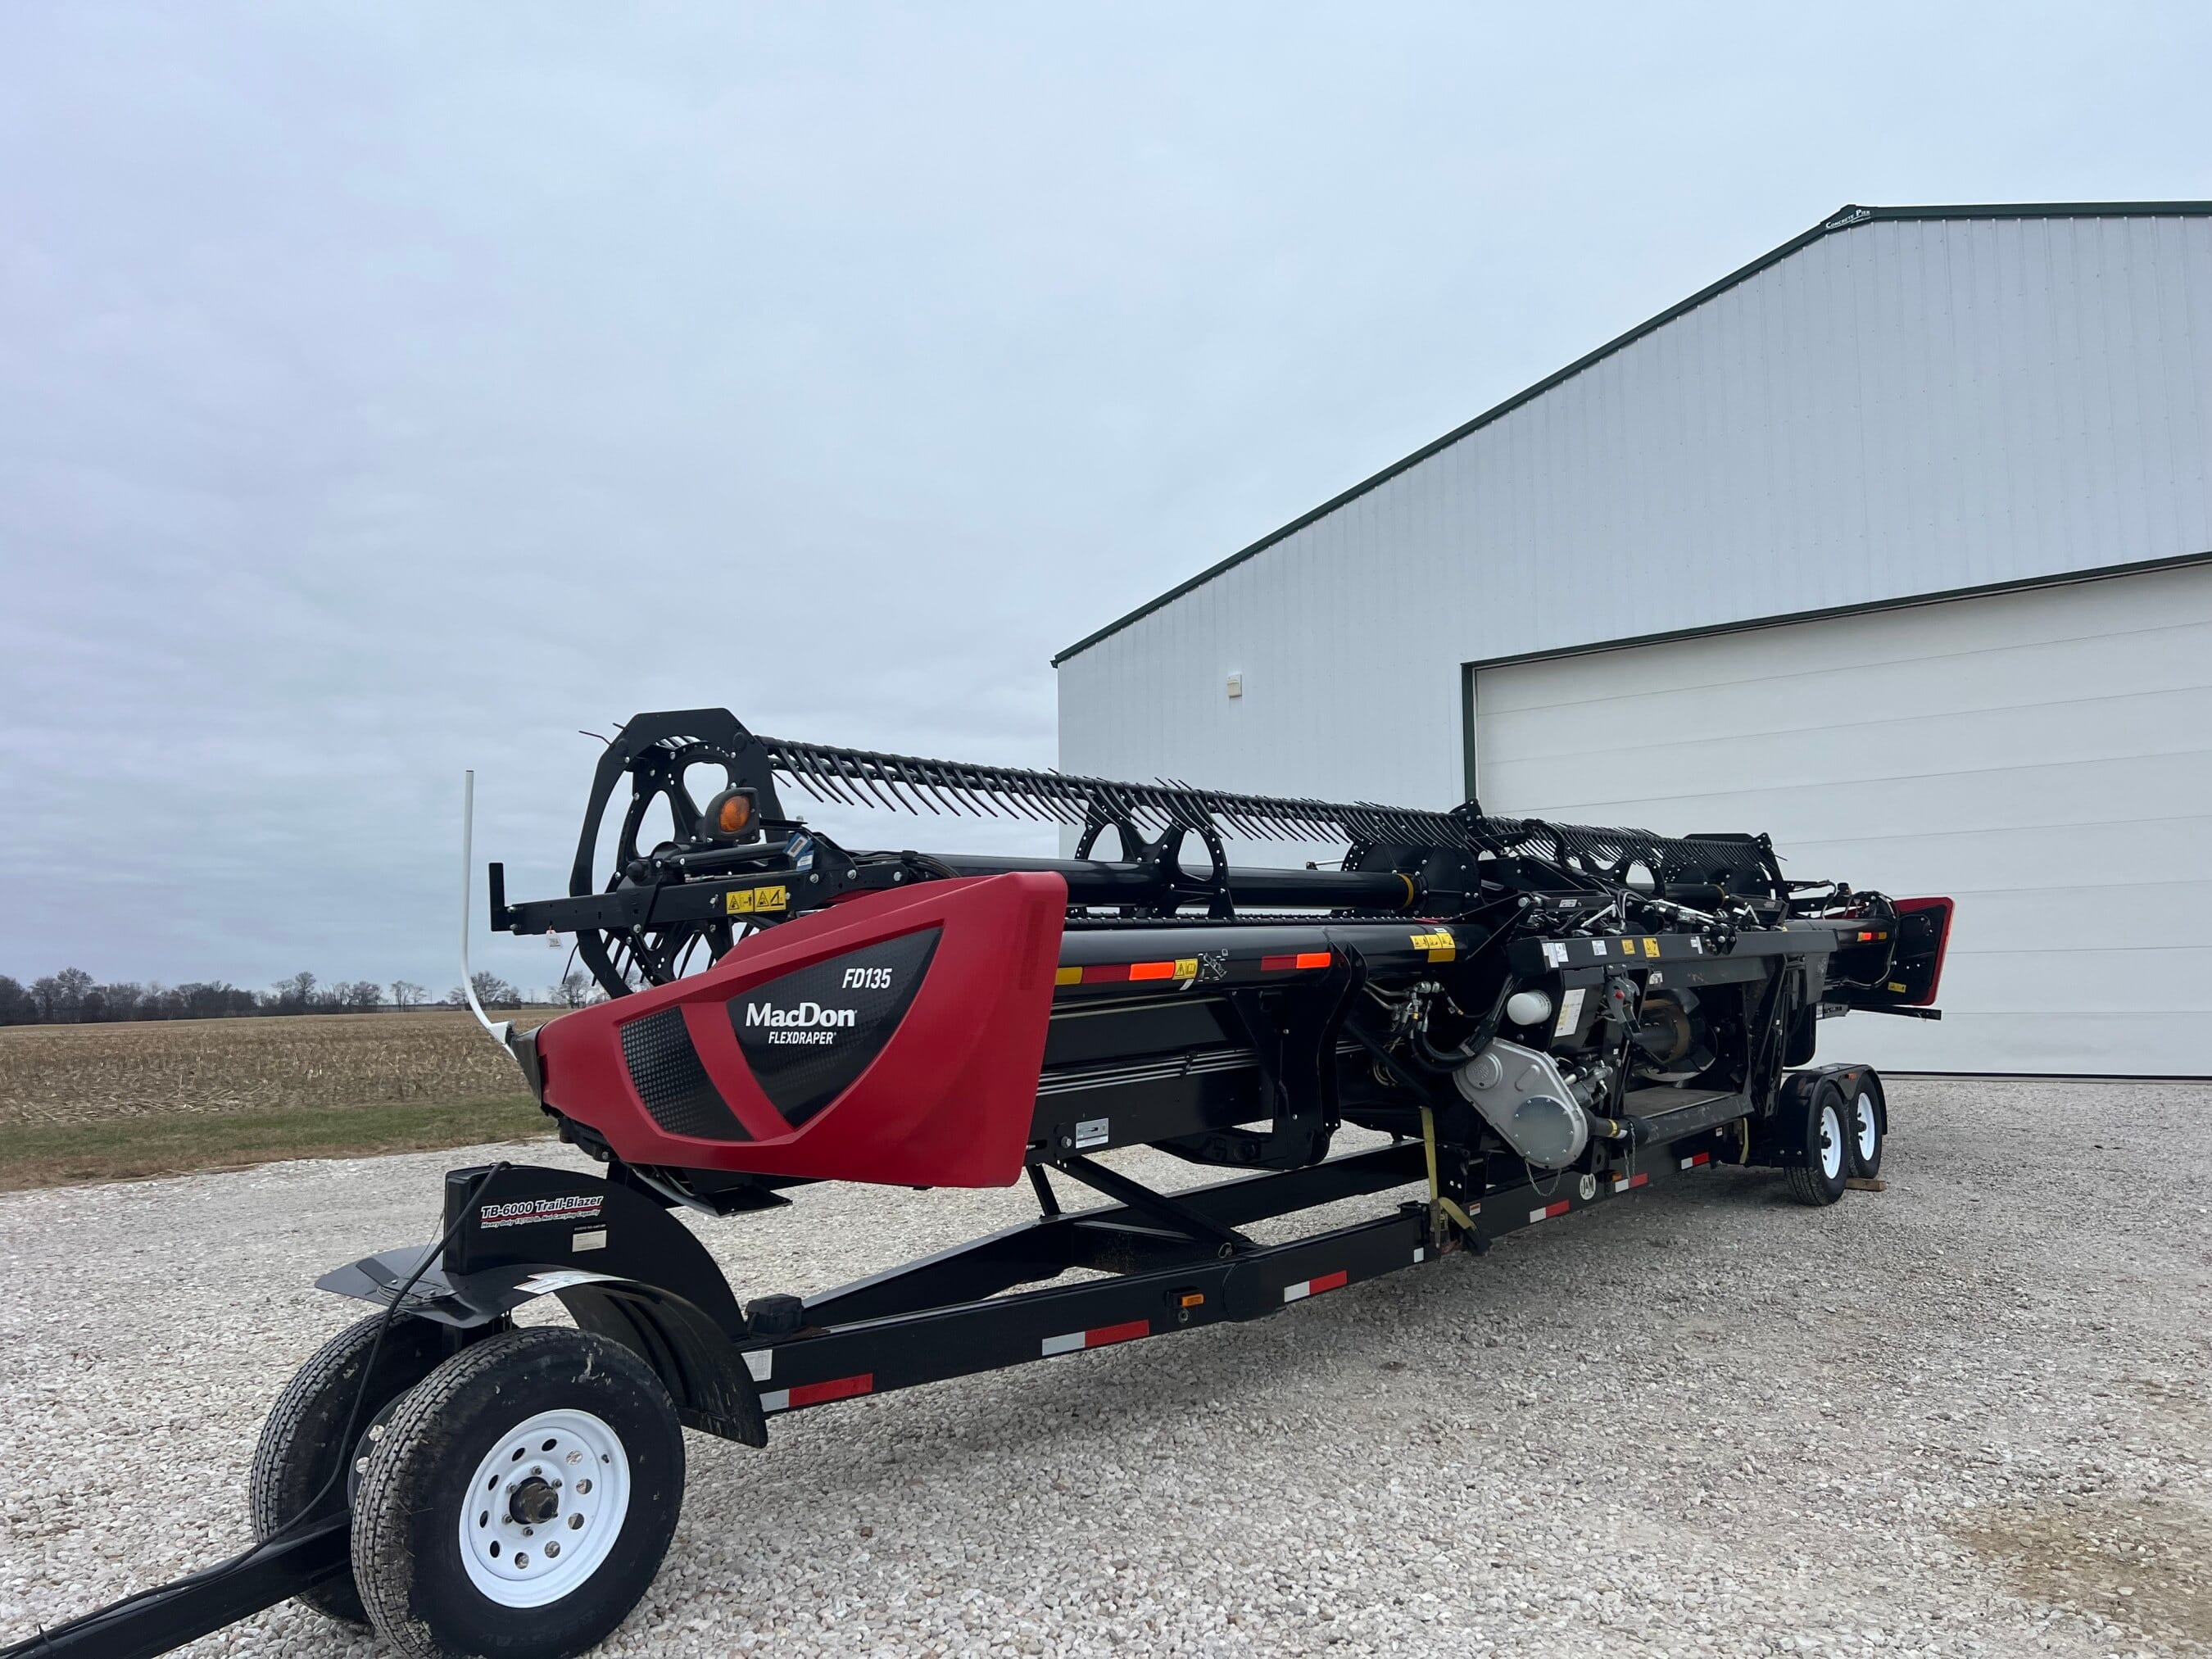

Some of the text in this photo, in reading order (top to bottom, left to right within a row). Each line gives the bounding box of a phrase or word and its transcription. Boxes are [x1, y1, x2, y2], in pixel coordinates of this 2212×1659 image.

[842, 968, 892, 989] FD135
[746, 1002, 856, 1027] MacDon
[768, 1031, 835, 1045] FLEXDRAPER
[481, 1195, 604, 1219] TB-6000 Trail-Blazer
